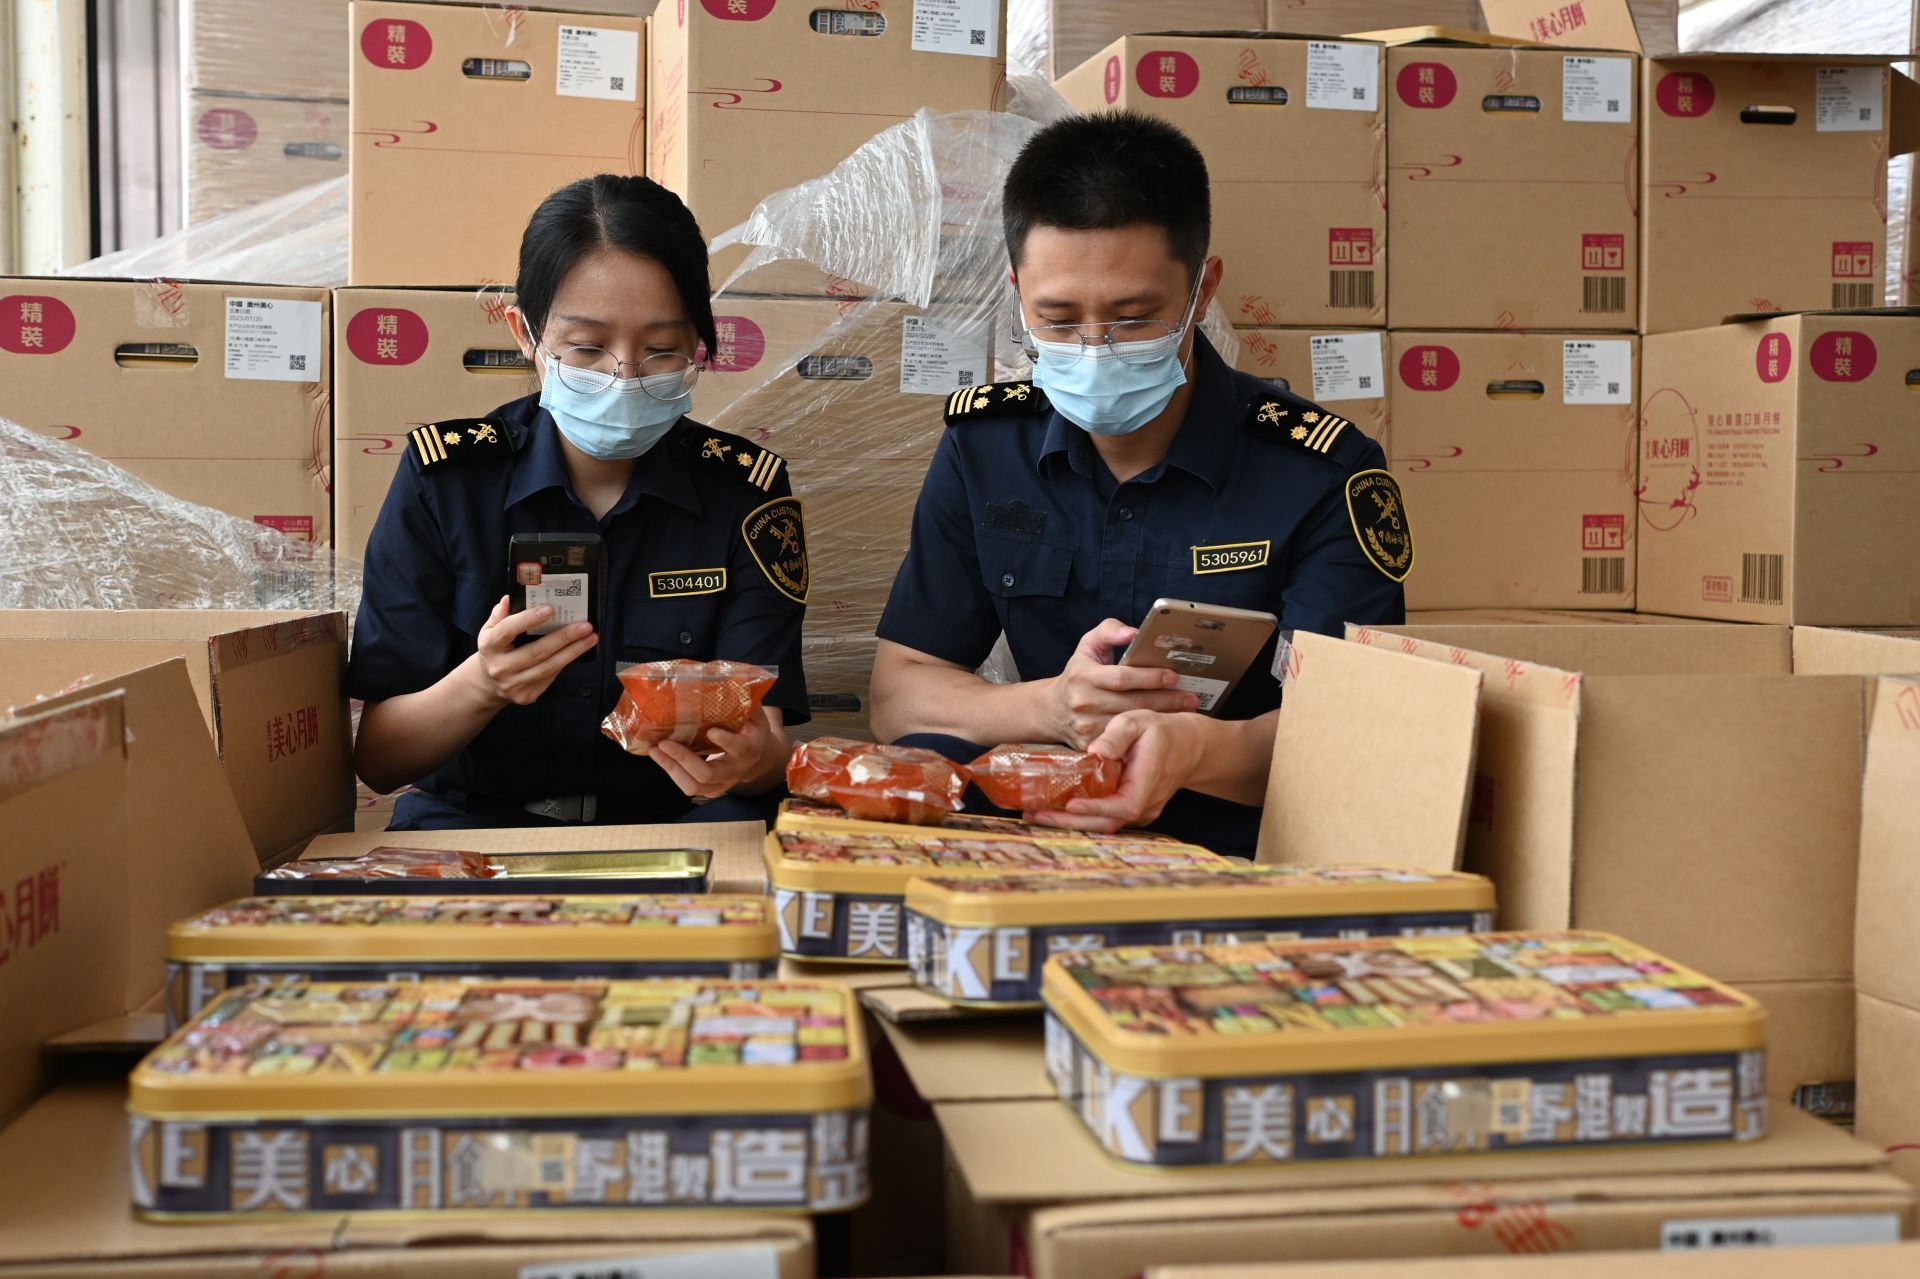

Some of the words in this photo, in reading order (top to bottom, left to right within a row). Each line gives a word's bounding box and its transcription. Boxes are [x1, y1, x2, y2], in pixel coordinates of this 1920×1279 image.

[387, 24, 406, 64] 精裝
[1159, 56, 1176, 93] 精裝
[1419, 69, 1435, 105] 精裝
[1678, 77, 1693, 112] 精裝
[20, 302, 43, 348] 精裝
[376, 315, 399, 360] 精裝
[716, 322, 736, 366] 精裝
[1421, 351, 1438, 386] 精裝
[1769, 338, 1779, 378] 精裝
[1835, 337, 1852, 377] 精裝
[1352, 477, 1375, 497] CHINA
[750, 514, 772, 540] CHINA
[1201, 549, 1263, 567] 5305961
[657, 576, 720, 590] 5304401
[273, 704, 319, 761] 美心月餅
[849, 902, 898, 957] 美
